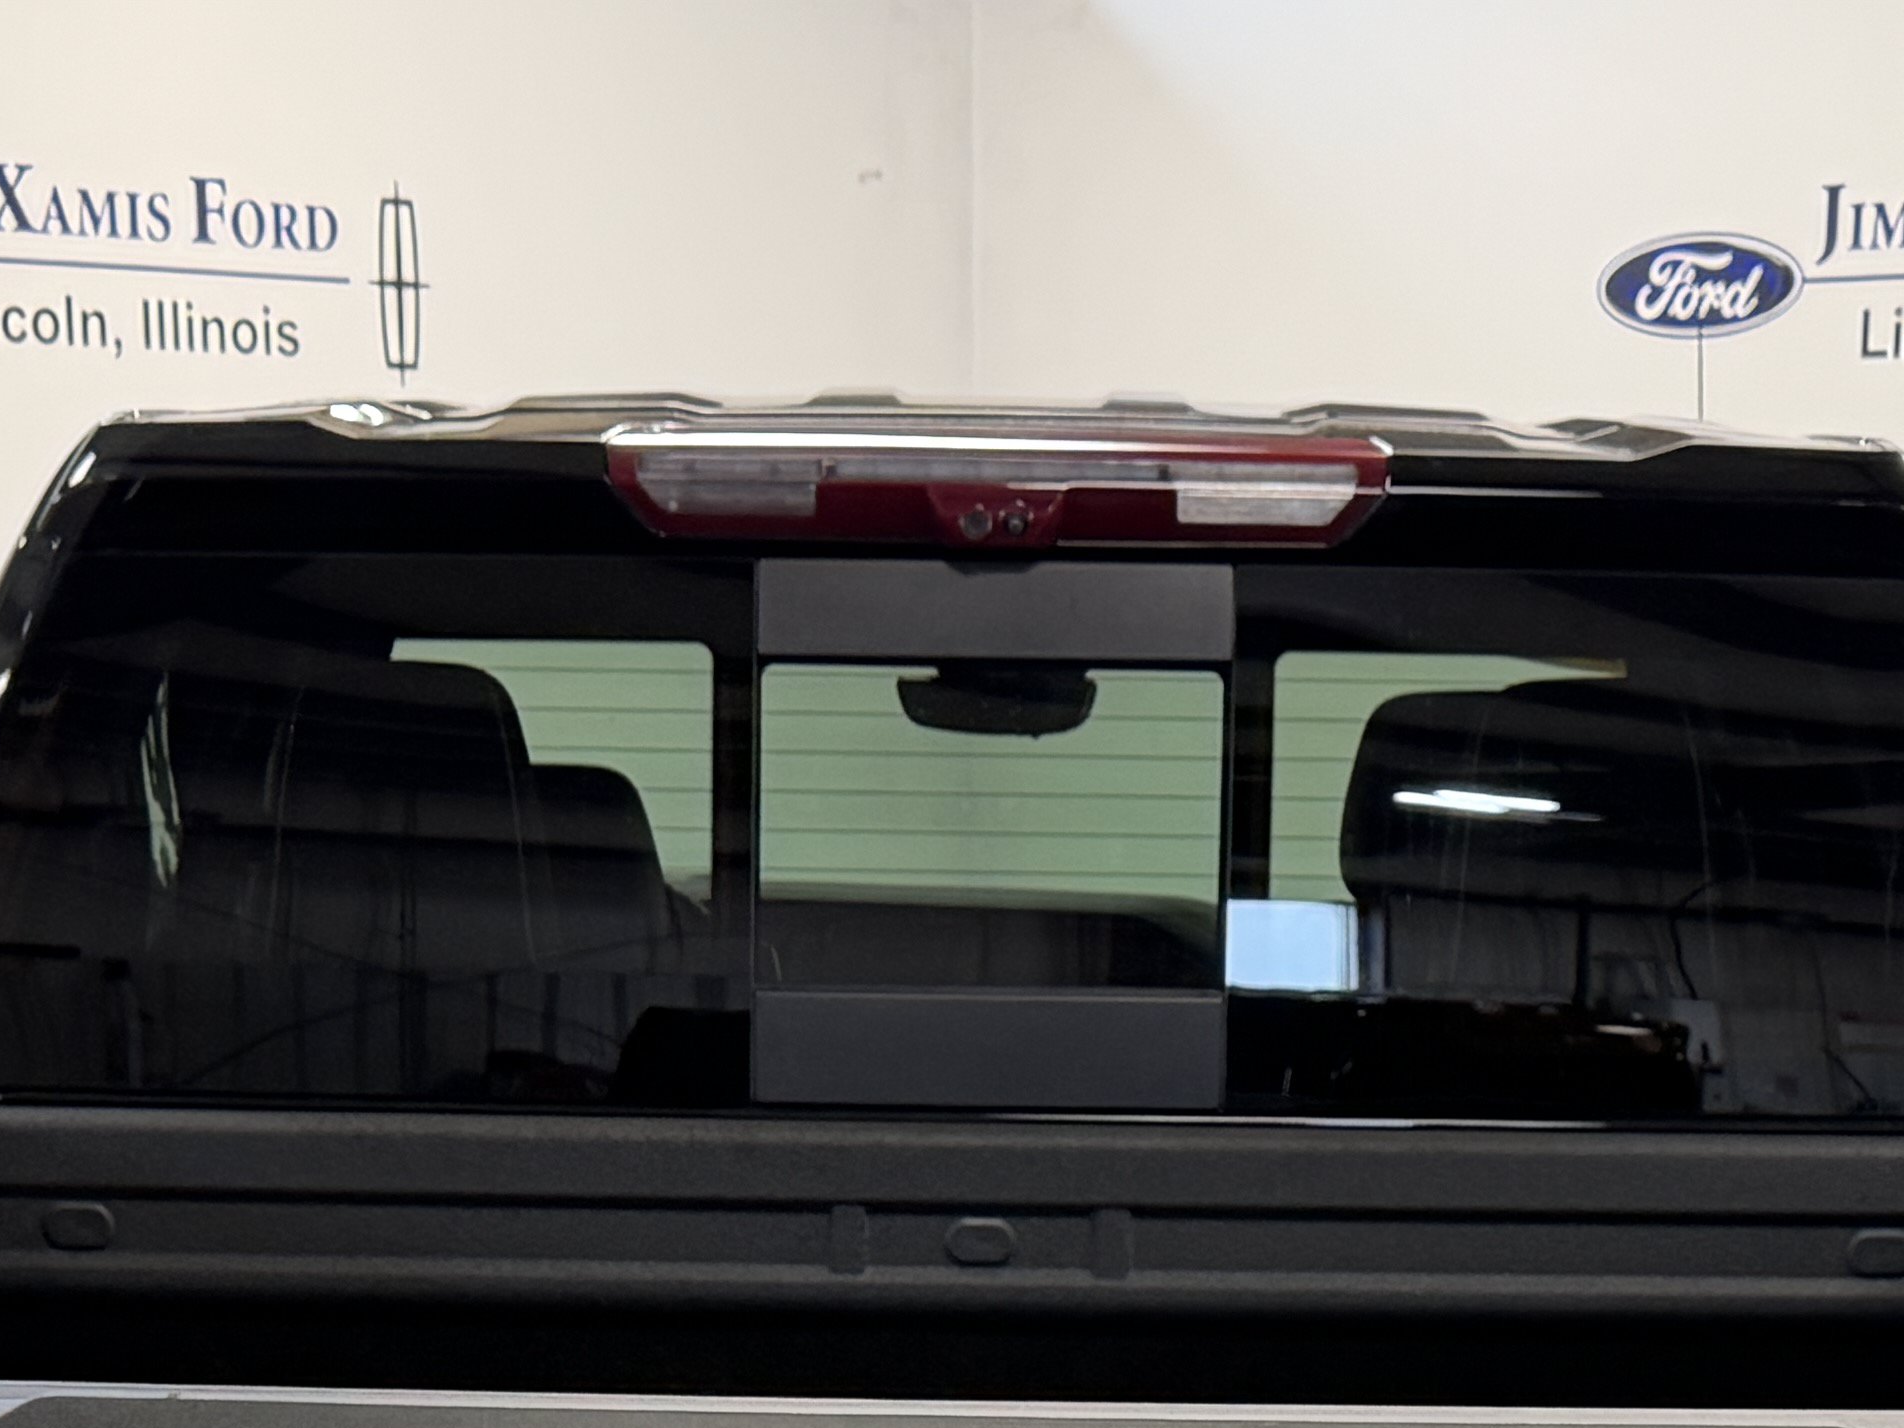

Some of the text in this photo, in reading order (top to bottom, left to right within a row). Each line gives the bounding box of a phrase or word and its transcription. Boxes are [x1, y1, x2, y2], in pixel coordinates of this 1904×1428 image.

[189, 176, 339, 252] FORD
[1633, 251, 1760, 321] Ford
[141, 298, 301, 357] Illinois
